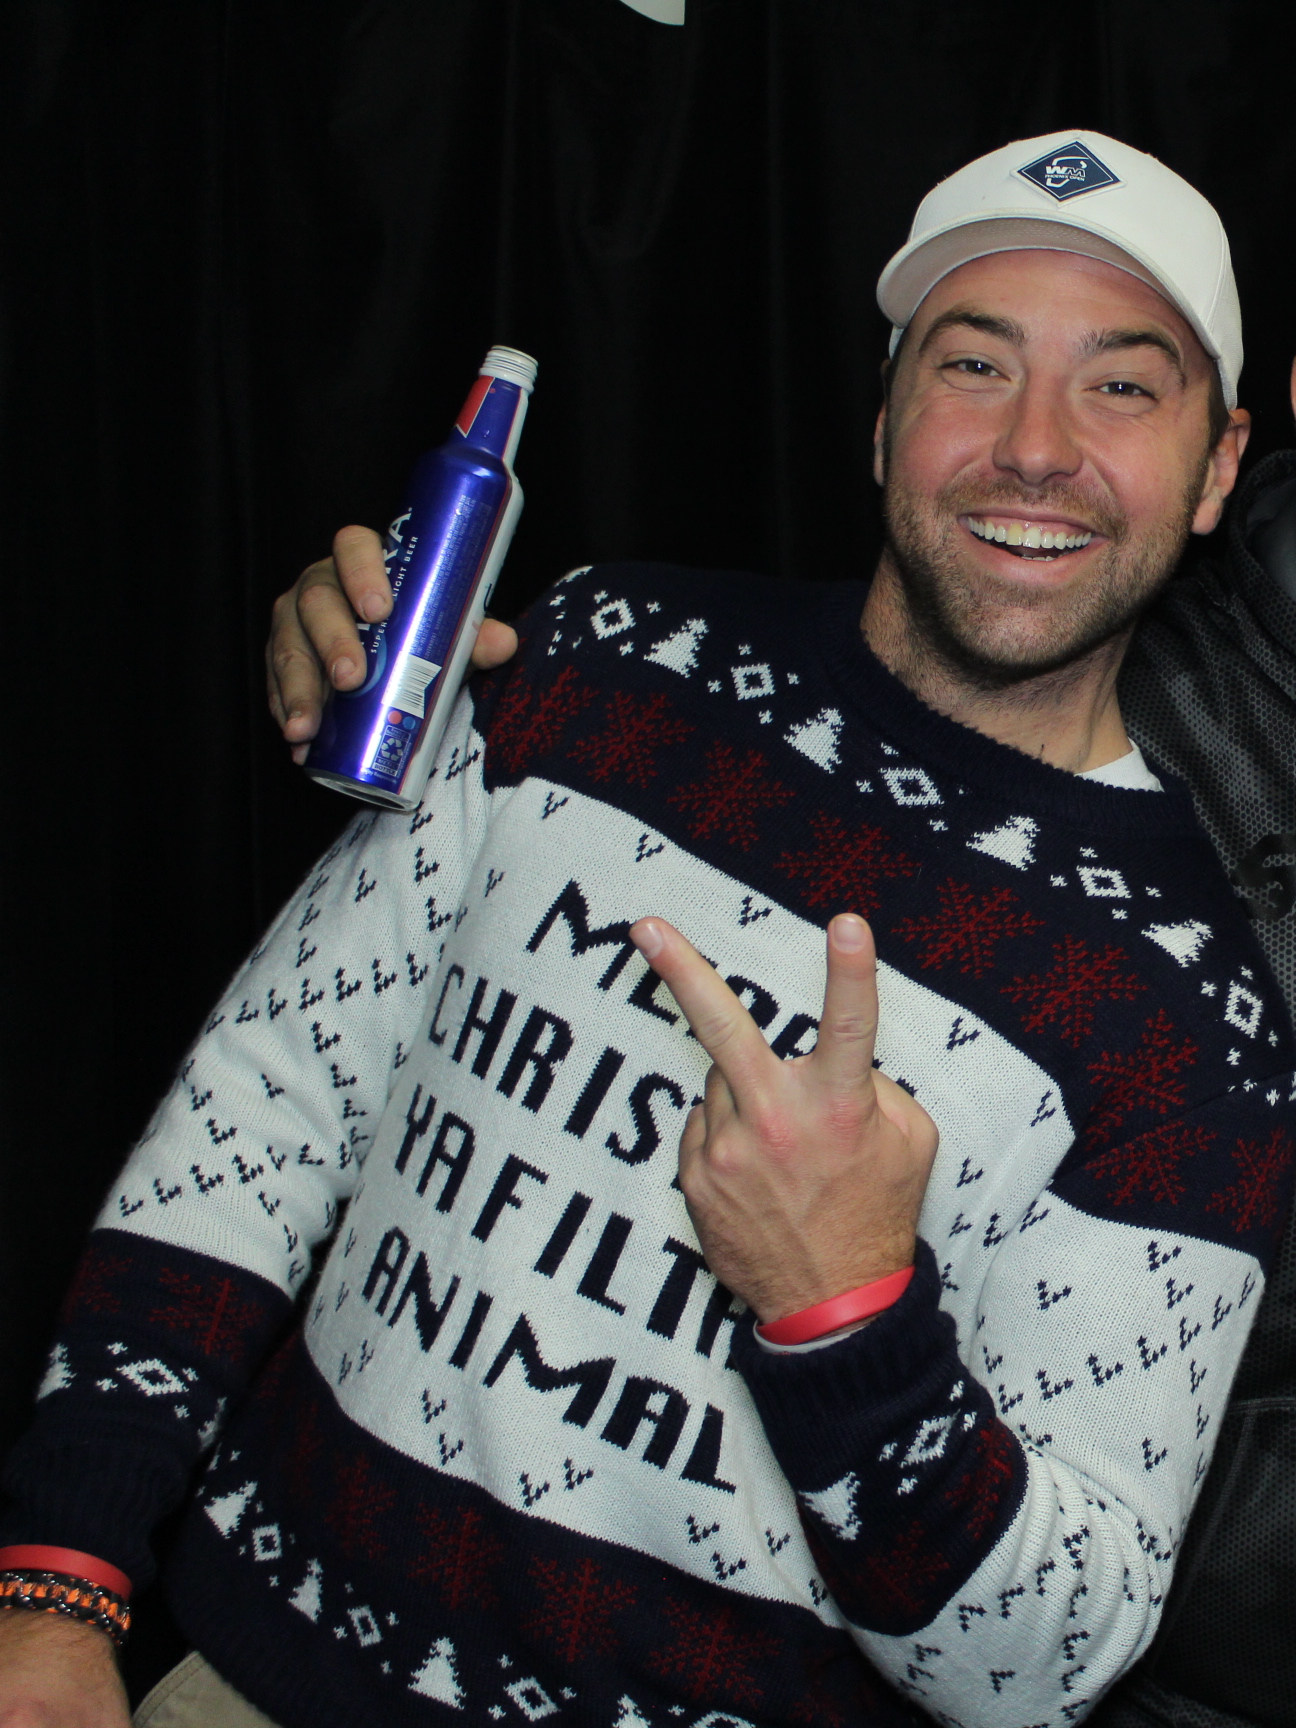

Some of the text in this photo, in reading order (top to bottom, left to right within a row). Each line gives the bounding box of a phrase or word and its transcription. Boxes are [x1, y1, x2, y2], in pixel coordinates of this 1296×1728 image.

[391, 565, 408, 598] LIGHT
[403, 535, 420, 563] BEER
[393, 1083, 478, 1214] YA
[361, 1226, 738, 1494] ANIMAL
